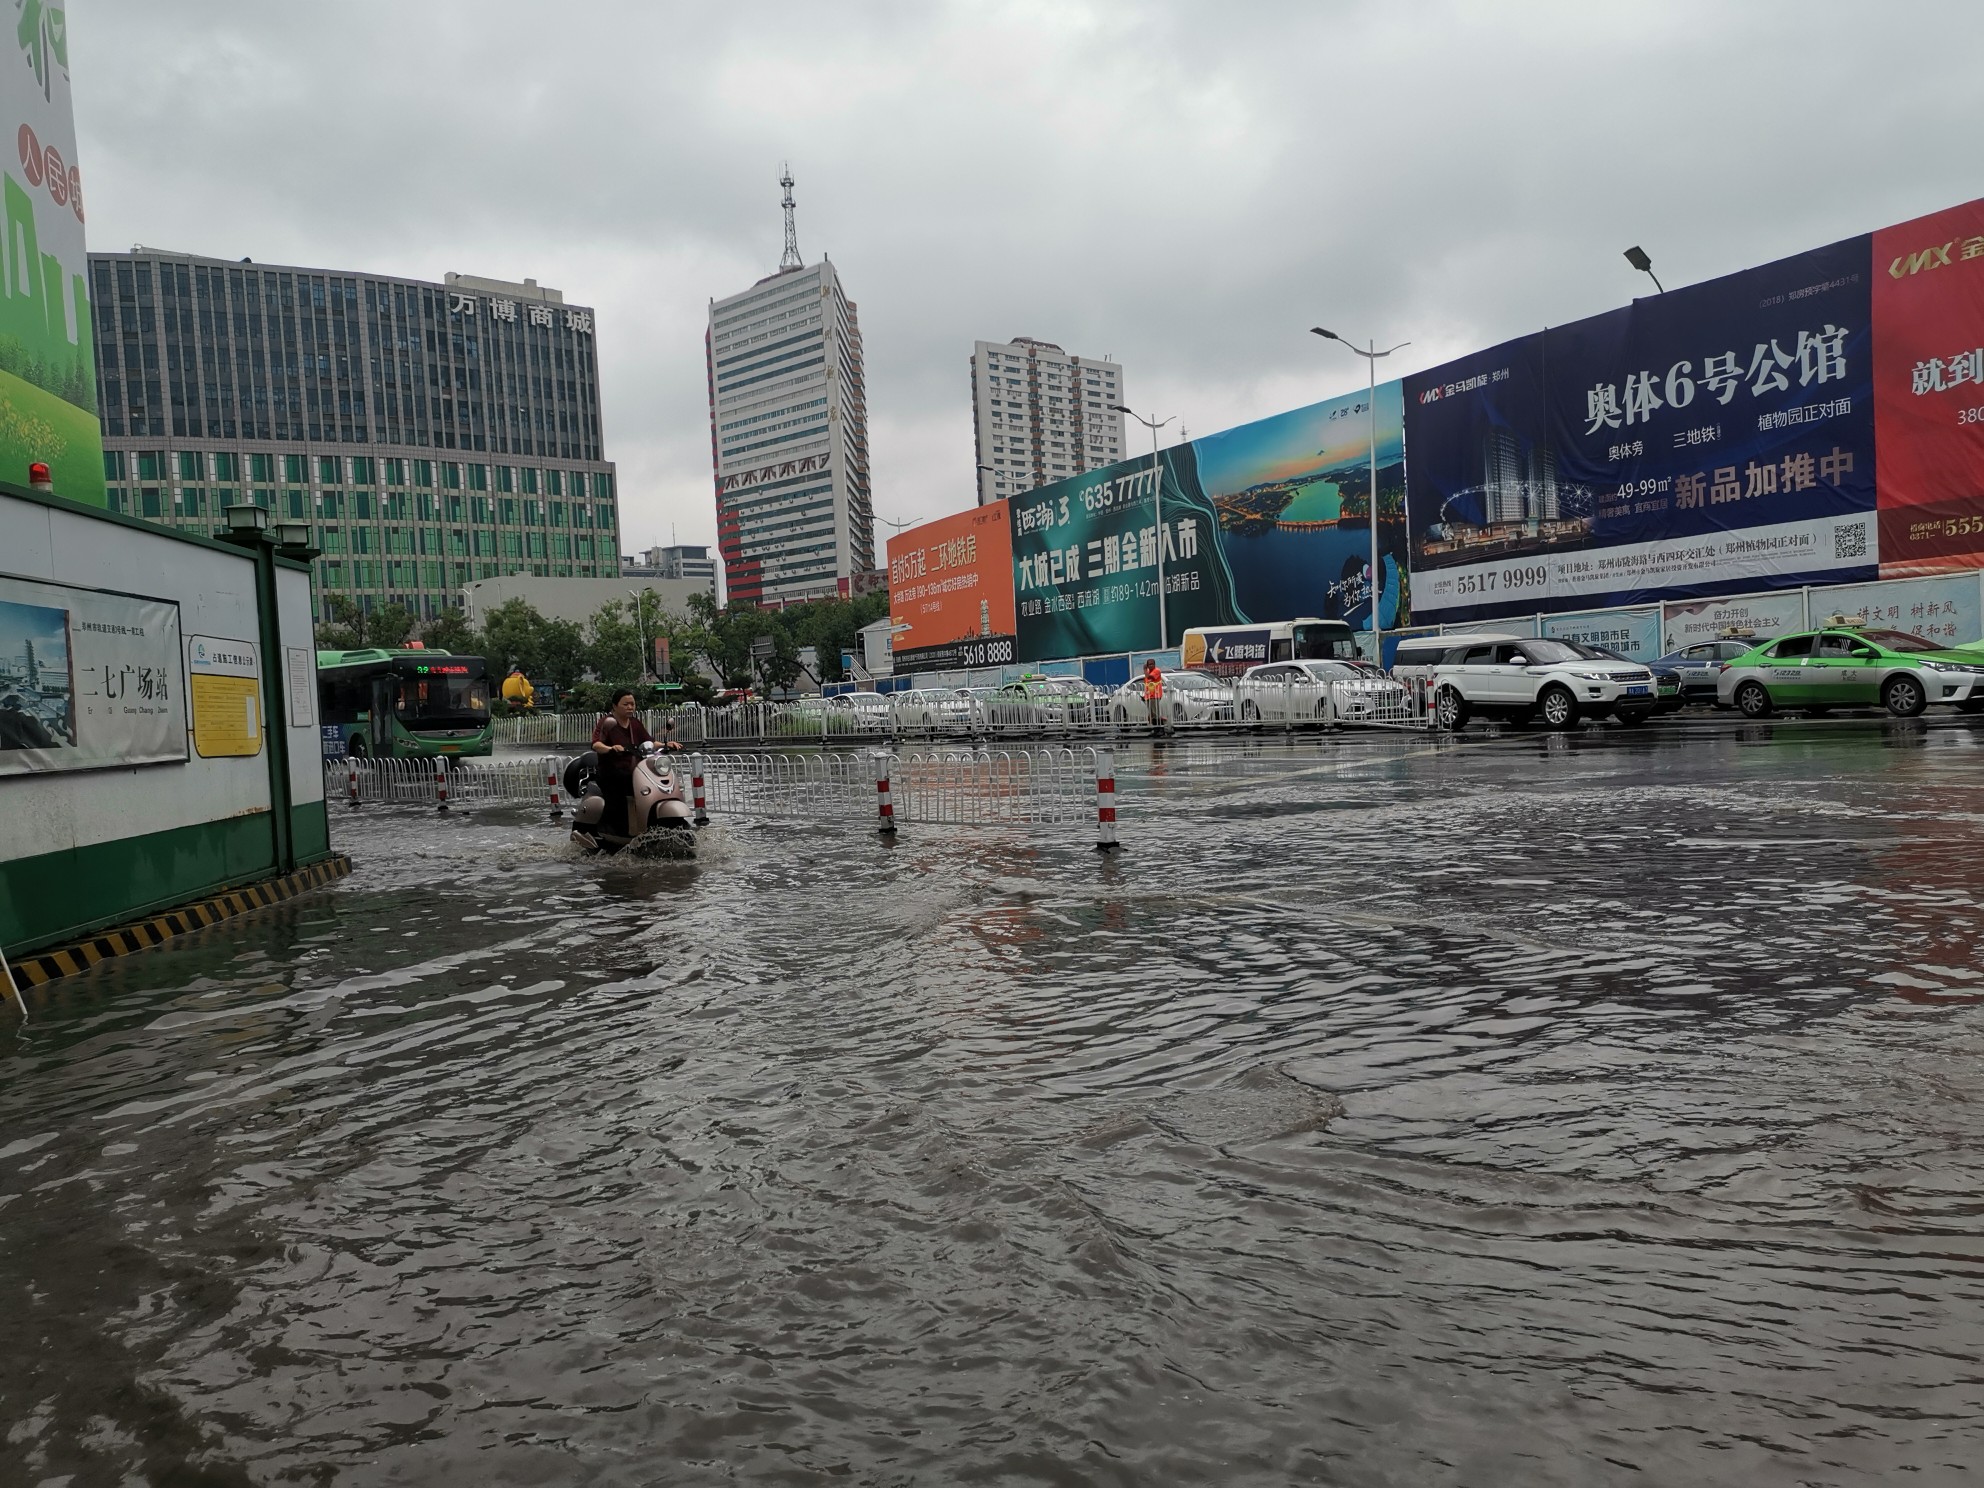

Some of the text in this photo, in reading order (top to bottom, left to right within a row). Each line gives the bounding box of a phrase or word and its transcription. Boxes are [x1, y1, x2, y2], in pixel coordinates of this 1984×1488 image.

[450, 293, 592, 334] 万博商城
[1584, 324, 1849, 436] 奥体6号公馆
[1912, 348, 1984, 395] 就到
[1757, 397, 1851, 431] 植物园正对面
[1608, 440, 1644, 462] 奥体旁
[1673, 425, 1716, 448] 三地铁
[1675, 446, 1854, 510] 新品加推中
[1085, 481, 1113, 511] 635
[892, 548, 926, 585] 首付5万起
[931, 533, 977, 571] 二环地铁房
[1019, 544, 1081, 591] 大城已成
[1087, 518, 1197, 578] 三期全新入市
[1458, 566, 1547, 594] 5517 9999
[1021, 599, 1042, 617] 农业路
[1044, 594, 1072, 614] 金水西路
[1077, 587, 1100, 609] 西流湖
[1714, 608, 1748, 620] 奋力开创
[1857, 600, 1957, 621] 讲文明 树新风
[1684, 617, 1780, 633] 新时代中国特色社会主义
[1911, 621, 1957, 637] 促和谐
[963, 643, 984, 665] 5618
[987, 640, 1012, 663] 8888
[1594, 641, 1640, 652] 明的城市
[81, 664, 168, 700] 二七广场站
